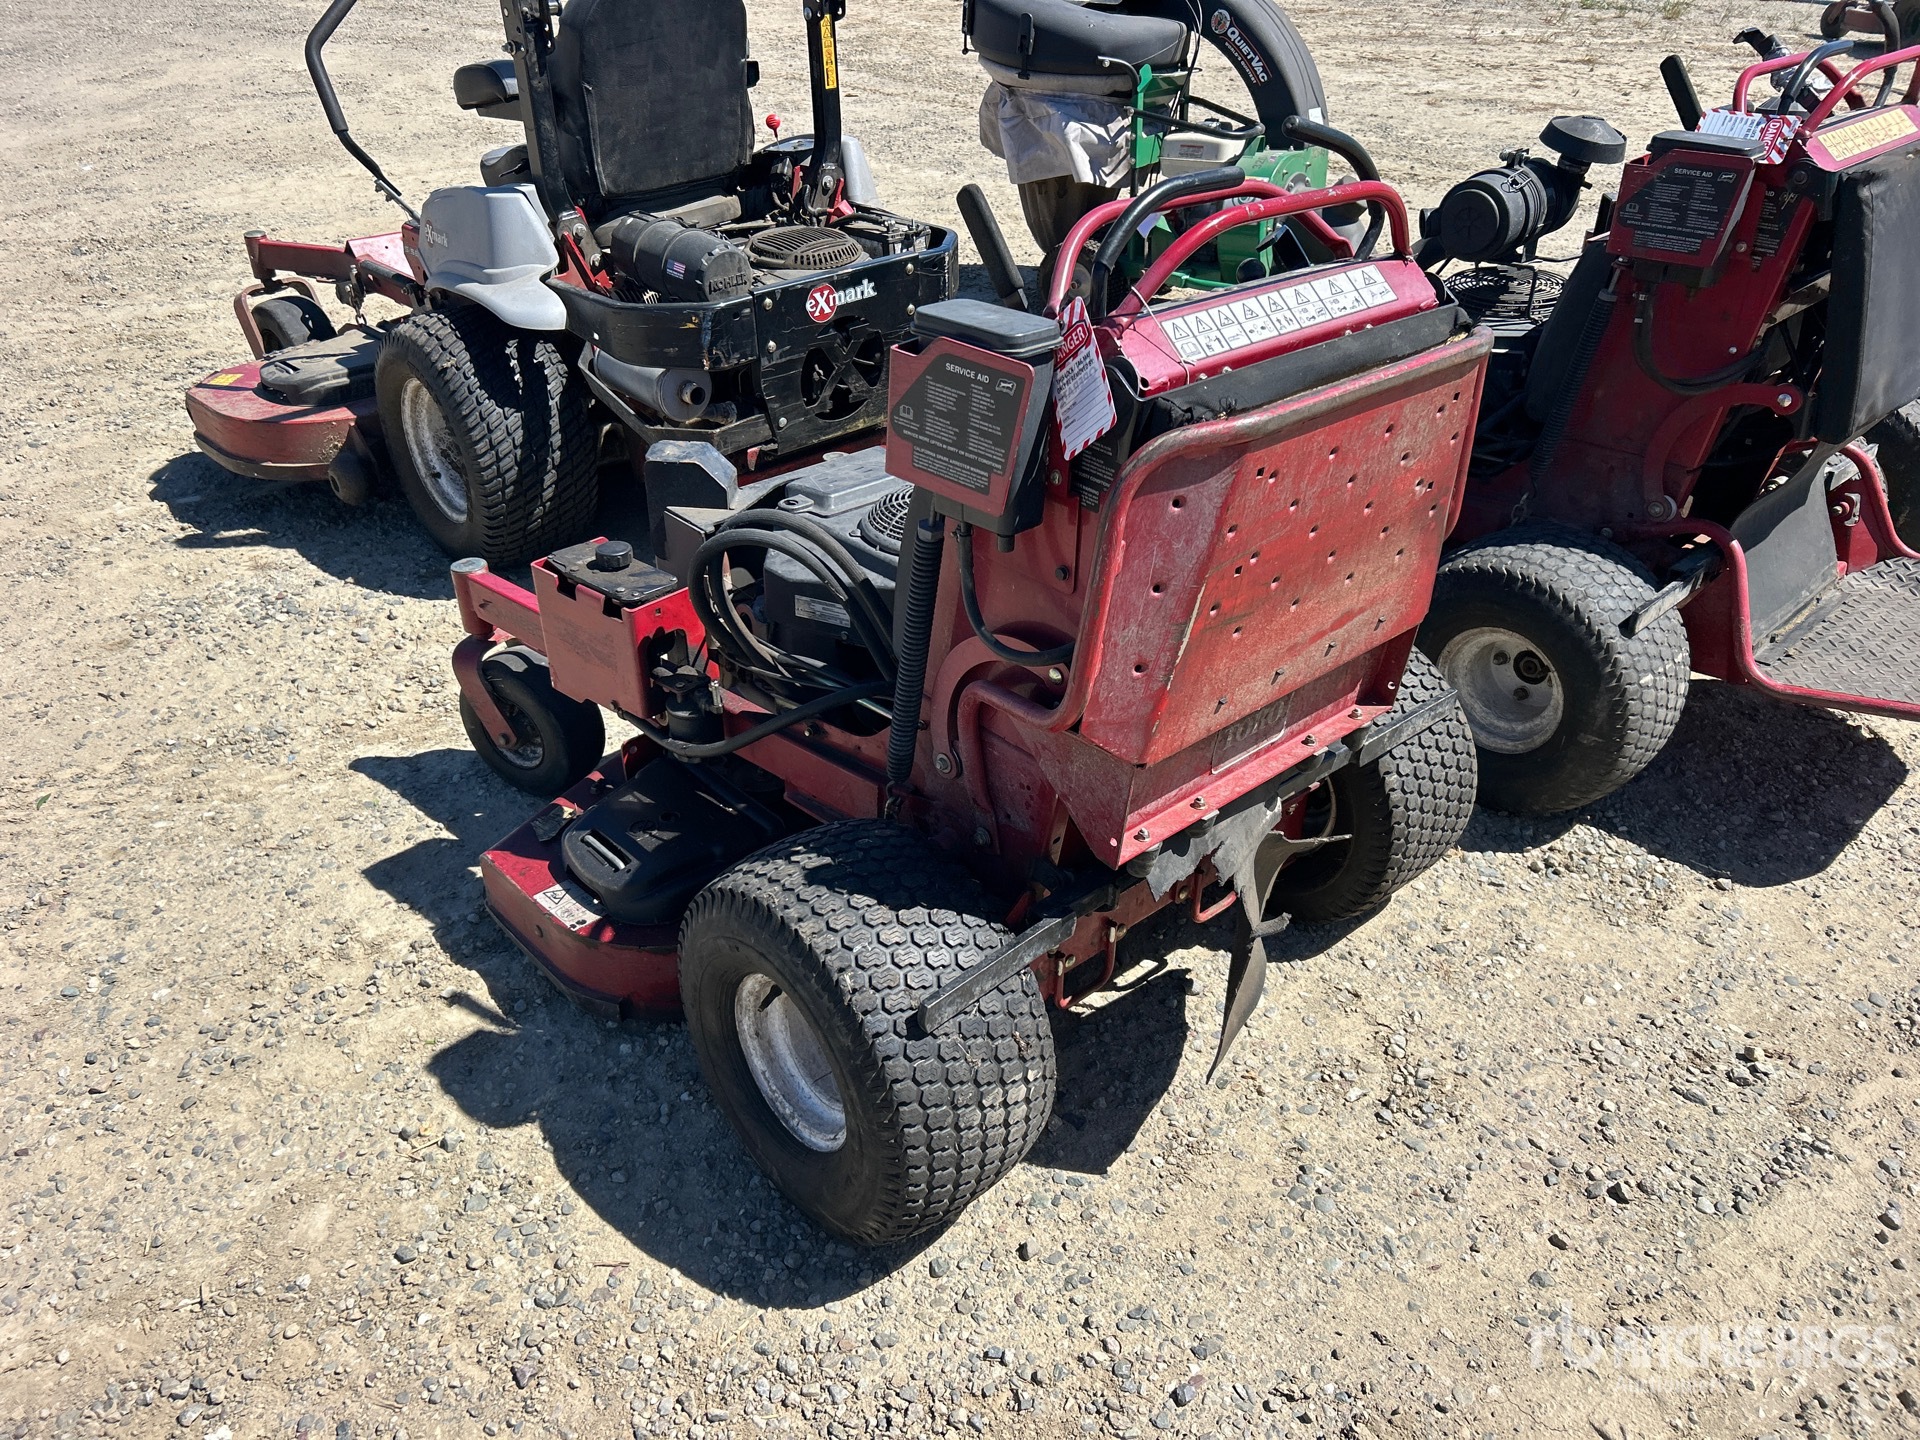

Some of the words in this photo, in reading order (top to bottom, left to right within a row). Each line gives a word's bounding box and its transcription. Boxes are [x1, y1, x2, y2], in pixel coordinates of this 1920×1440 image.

[1674, 167, 1701, 178] SERVICE
[1701, 170, 1714, 178] AID
[1056, 326, 1085, 362] ANGER
[945, 362, 976, 380] SERVICE
[976, 372, 990, 384] AID
